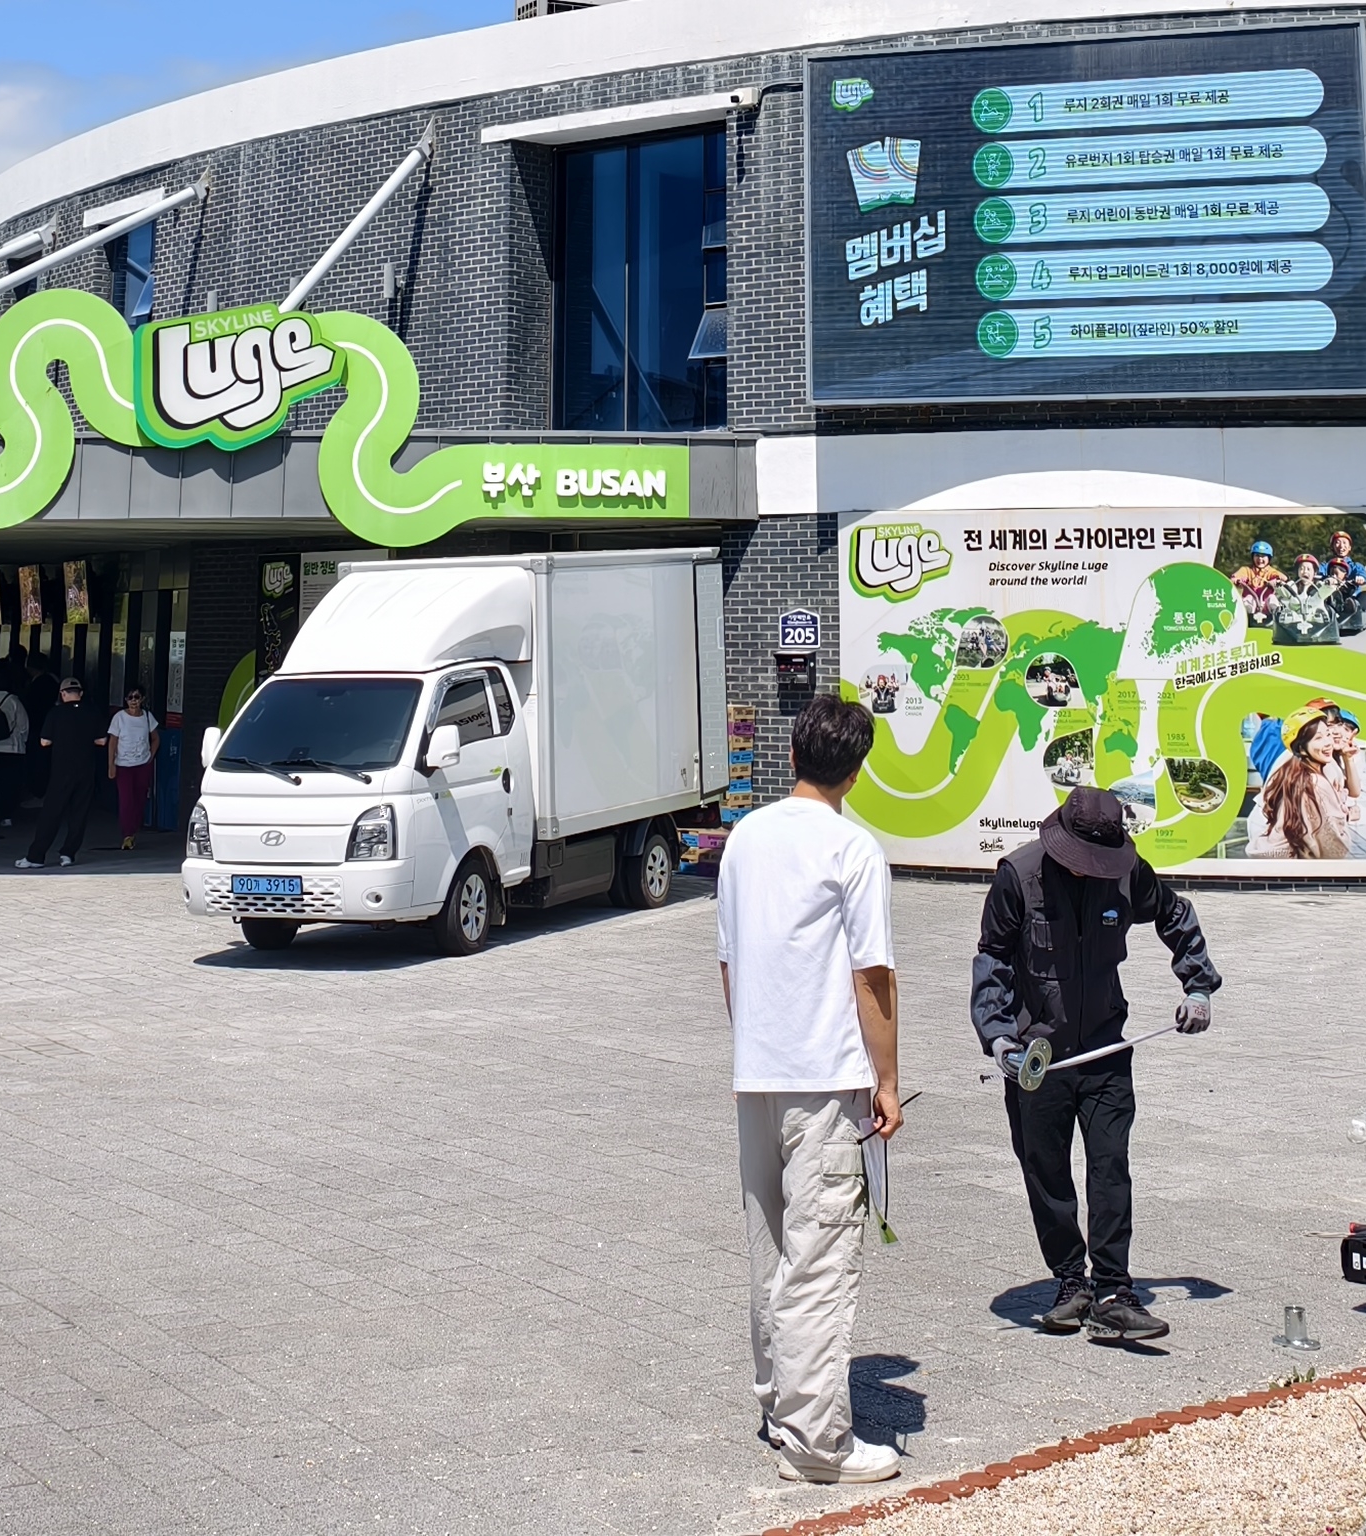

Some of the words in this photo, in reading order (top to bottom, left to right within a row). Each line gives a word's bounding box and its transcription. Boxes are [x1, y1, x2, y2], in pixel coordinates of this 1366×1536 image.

[1028, 92, 1044, 123] 1
[1064, 97, 1087, 112] 루지
[1091, 95, 1124, 111] 2회권
[1127, 93, 1151, 109] 매일
[1155, 92, 1174, 107] 1회
[1176, 91, 1202, 106] 무료
[1205, 89, 1230, 105] 제공
[1028, 147, 1047, 179] 2
[1065, 153, 1113, 169] 유로번지
[1117, 151, 1135, 166] 1회
[1138, 148, 1175, 165] 탑승권
[1179, 147, 1203, 163] 매일
[1207, 145, 1226, 161] 1회
[1230, 144, 1255, 160] 무료
[1258, 143, 1284, 159] 제공
[1029, 202, 1047, 235] 3
[1067, 209, 1090, 224] 루지
[1094, 207, 1131, 222] 어린이
[1135, 205, 1171, 221] 동반권
[1175, 203, 1199, 219] 매일
[1202, 203, 1222, 218] 1회
[1225, 202, 1251, 216] 무료
[1254, 201, 1280, 216] 제공
[845, 209, 946, 281] 멤버십
[1031, 260, 1052, 290] 4
[1069, 266, 1093, 281] 루지
[1096, 264, 1170, 281] 업그레이드권
[1174, 263, 1192, 277] 1회
[1196, 260, 1263, 279] 8,000원에
[1266, 259, 1293, 275] 제공
[859, 268, 928, 327] 혜택
[194, 309, 277, 339] SKYLINE
[1033, 316, 1052, 349] 5
[1070, 322, 1177, 340] 하이플라이(짚라인)
[1180, 321, 1210, 336] 50%
[1214, 319, 1239, 335] 할인
[152, 317, 337, 432] Luge
[481, 462, 543, 500] 부산
[555, 468, 667, 498] BUSAN
[878, 524, 922, 539] SKYLINE
[963, 528, 983, 552] 전
[989, 528, 1048, 552] 세계의
[1054, 527, 1156, 551] 스카이라인
[1162, 527, 1204, 550] 루지
[303, 561, 319, 576] 일반
[857, 527, 953, 594] Luge
[988, 561, 1036, 573] Discover
[1038, 560, 1079, 574] Skyline
[1082, 560, 1109, 573] Luge
[988, 576, 1028, 587] around
[1030, 575, 1049, 587] the
[1202, 588, 1226, 602] 부산
[1173, 612, 1197, 625] 통영
[784, 627, 815, 644] 205
[265, 878, 295, 893] 3915
